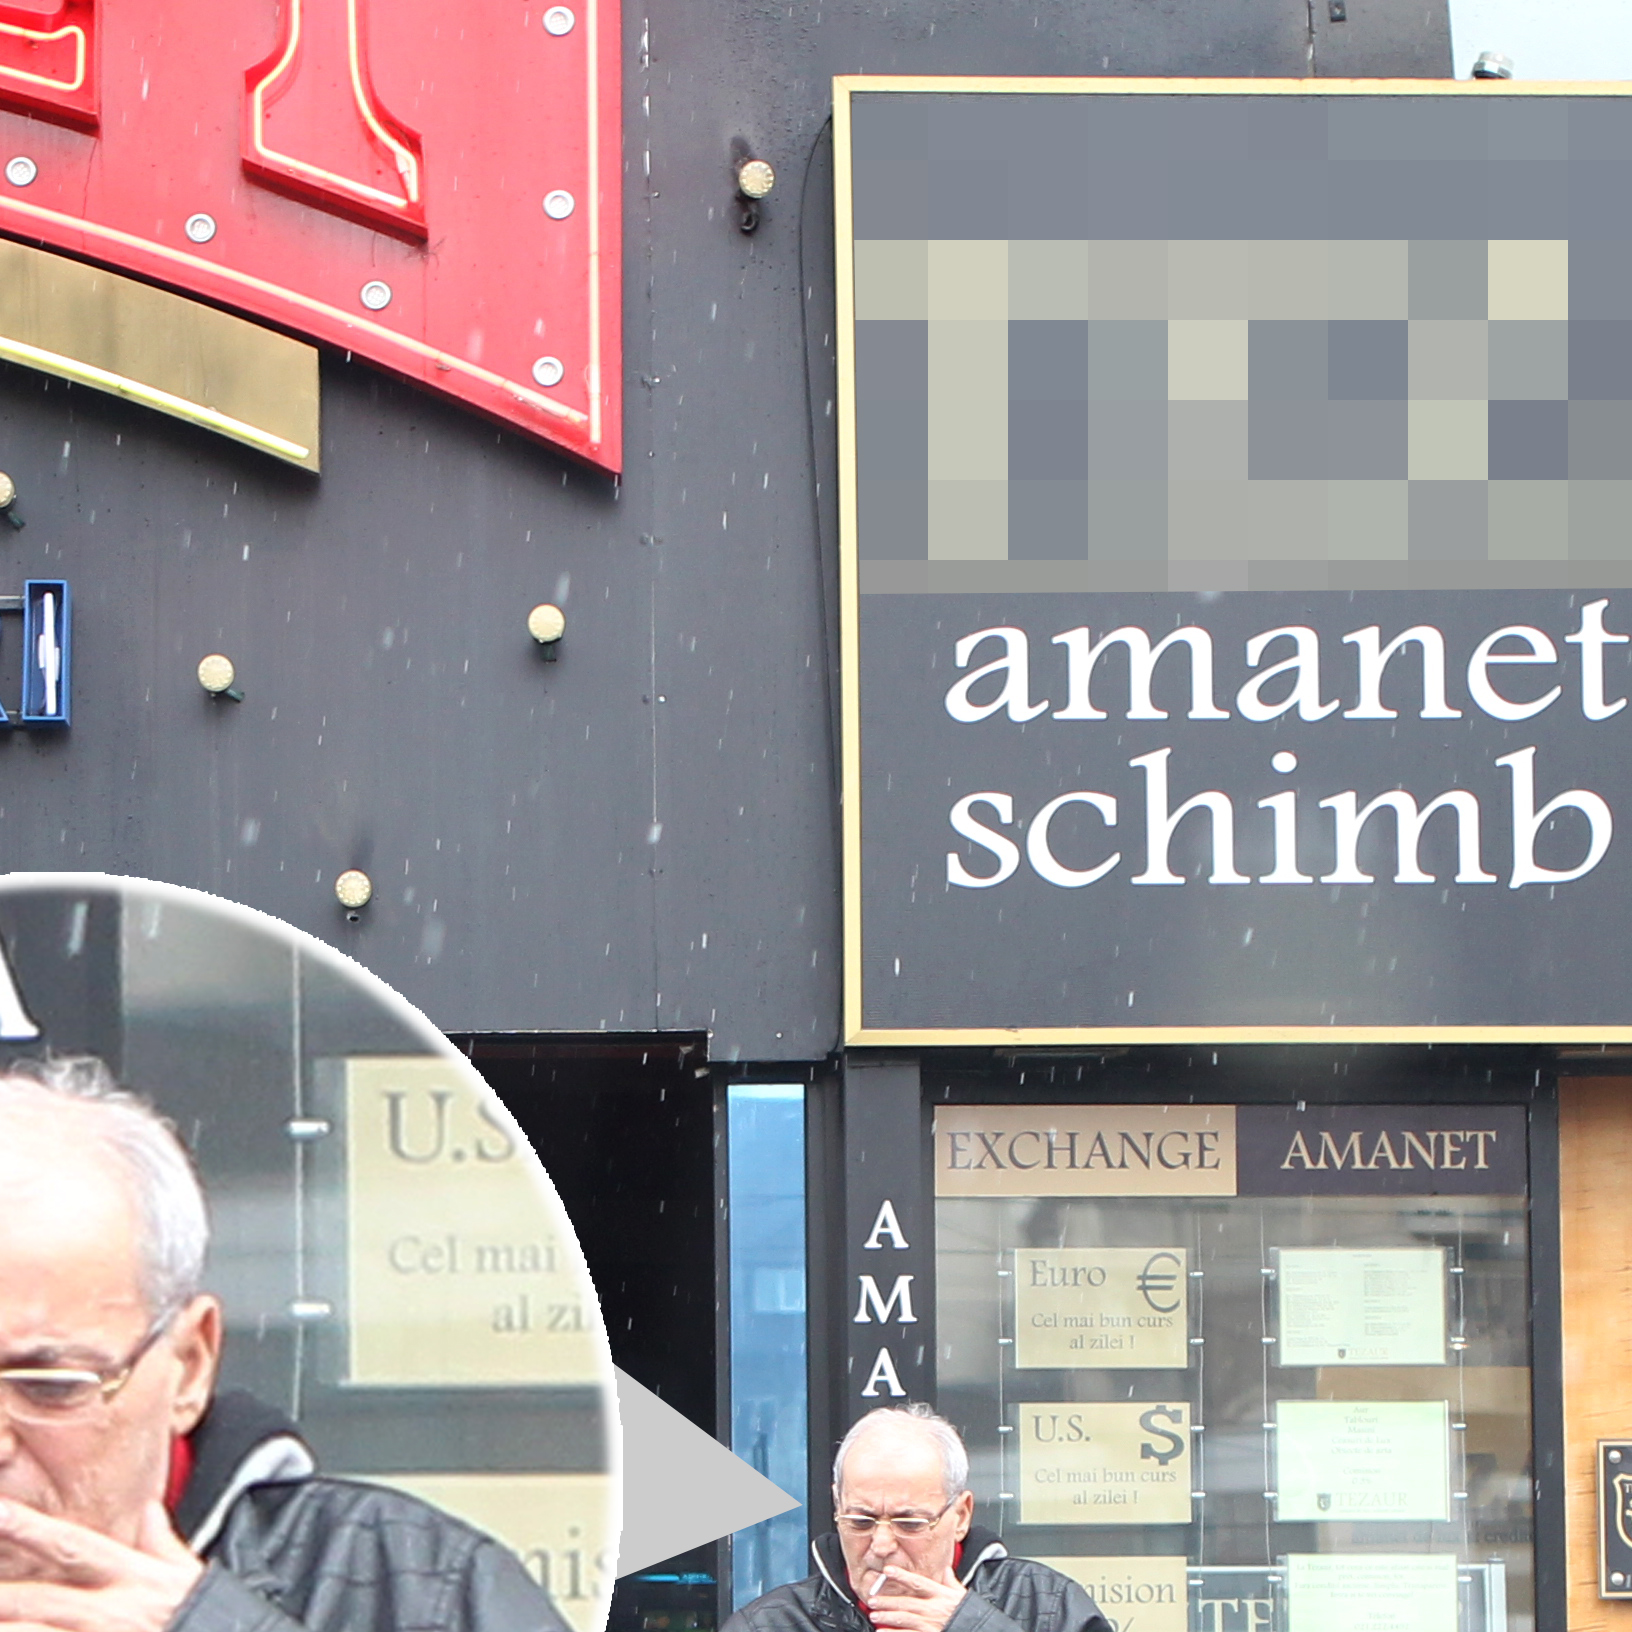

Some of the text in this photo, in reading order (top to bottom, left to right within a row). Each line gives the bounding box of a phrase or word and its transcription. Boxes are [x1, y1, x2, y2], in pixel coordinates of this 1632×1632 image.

[944, 598, 1630, 723] amanet
[946, 746, 1613, 889] schimb
[945, 1130, 1221, 1171] EXCHANGE
[1280, 1130, 1497, 1171] AMANET
[388, 1235, 460, 1275] Cel
[1029, 1258, 1107, 1288] Euro
[1031, 1312, 1174, 1329] Cel mai bun curs
[1068, 1334, 1085, 1350] al
[1089, 1334, 1124, 1350] zilei
[1032, 1413, 1092, 1443] U.S.
[1034, 1468, 1178, 1485] Cel mai bun curs
[1072, 1489, 1088, 1506] al
[1092, 1489, 1128, 1506] zilei
[1335, 1491, 1410, 1507] TEZAUR
